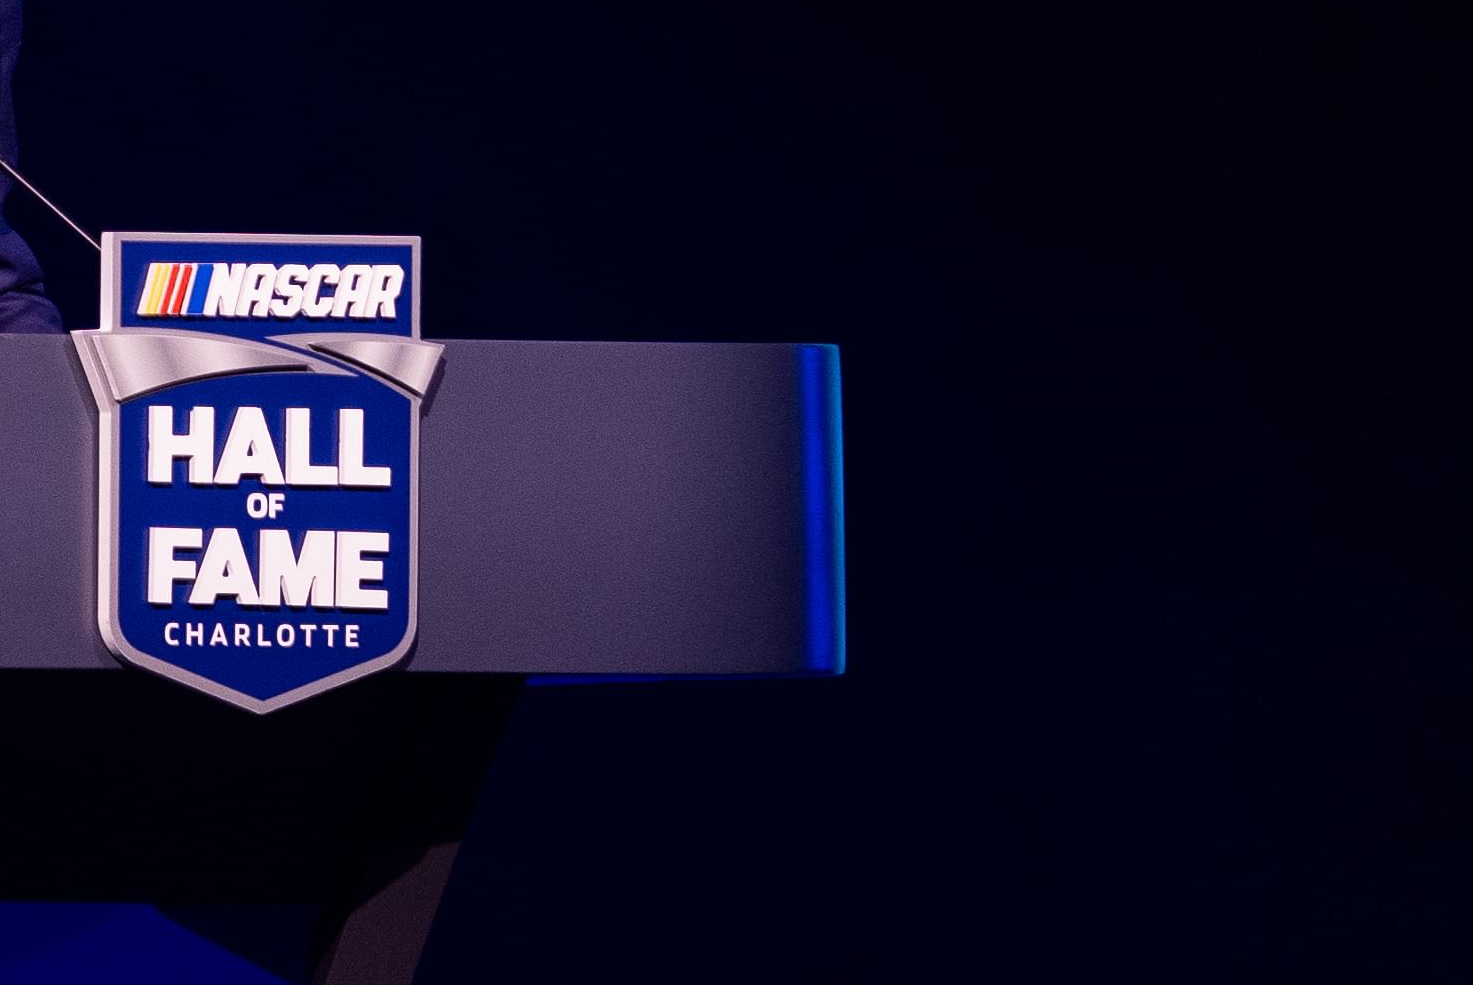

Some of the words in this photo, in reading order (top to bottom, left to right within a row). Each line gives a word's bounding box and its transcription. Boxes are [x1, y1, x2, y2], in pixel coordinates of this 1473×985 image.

[204, 263, 405, 318] NASCAR
[148, 405, 391, 487] HALL
[246, 493, 285, 519] OF
[148, 527, 391, 609] FAME
[164, 622, 361, 648] CHARLOTTE
